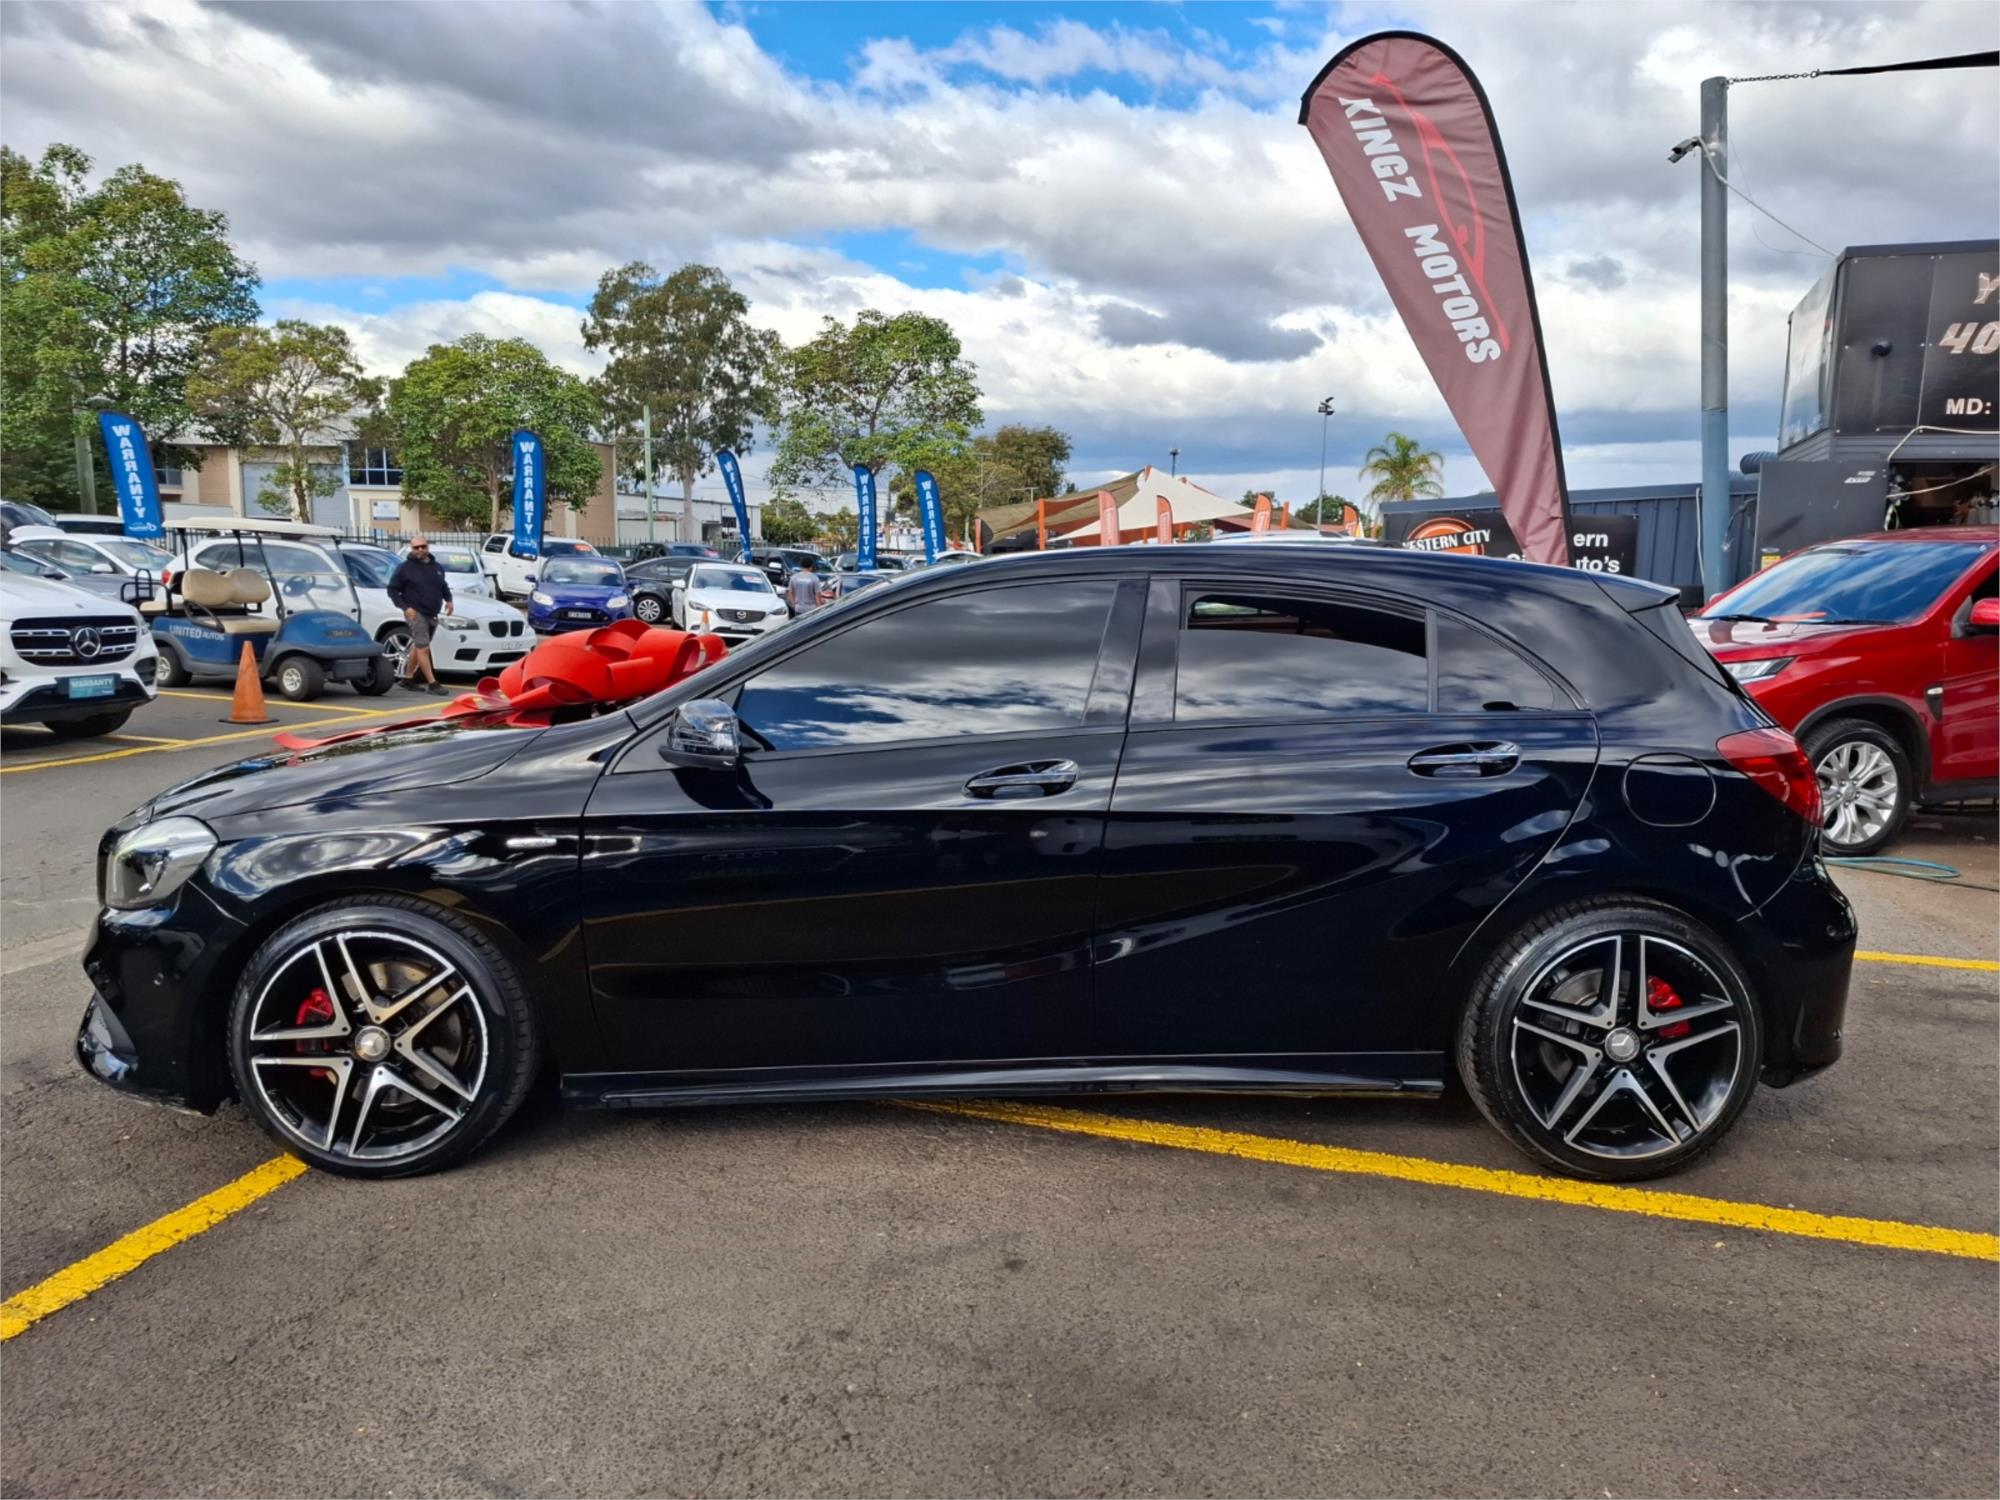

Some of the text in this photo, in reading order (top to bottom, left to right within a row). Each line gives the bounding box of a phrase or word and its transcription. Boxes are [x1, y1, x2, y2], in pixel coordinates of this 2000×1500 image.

[1338, 96, 1501, 363] KINGZ MOTORS
[1945, 398, 1992, 415] MD:
[1463, 529, 1491, 545] CITY
[168, 624, 202, 639] UNITED
